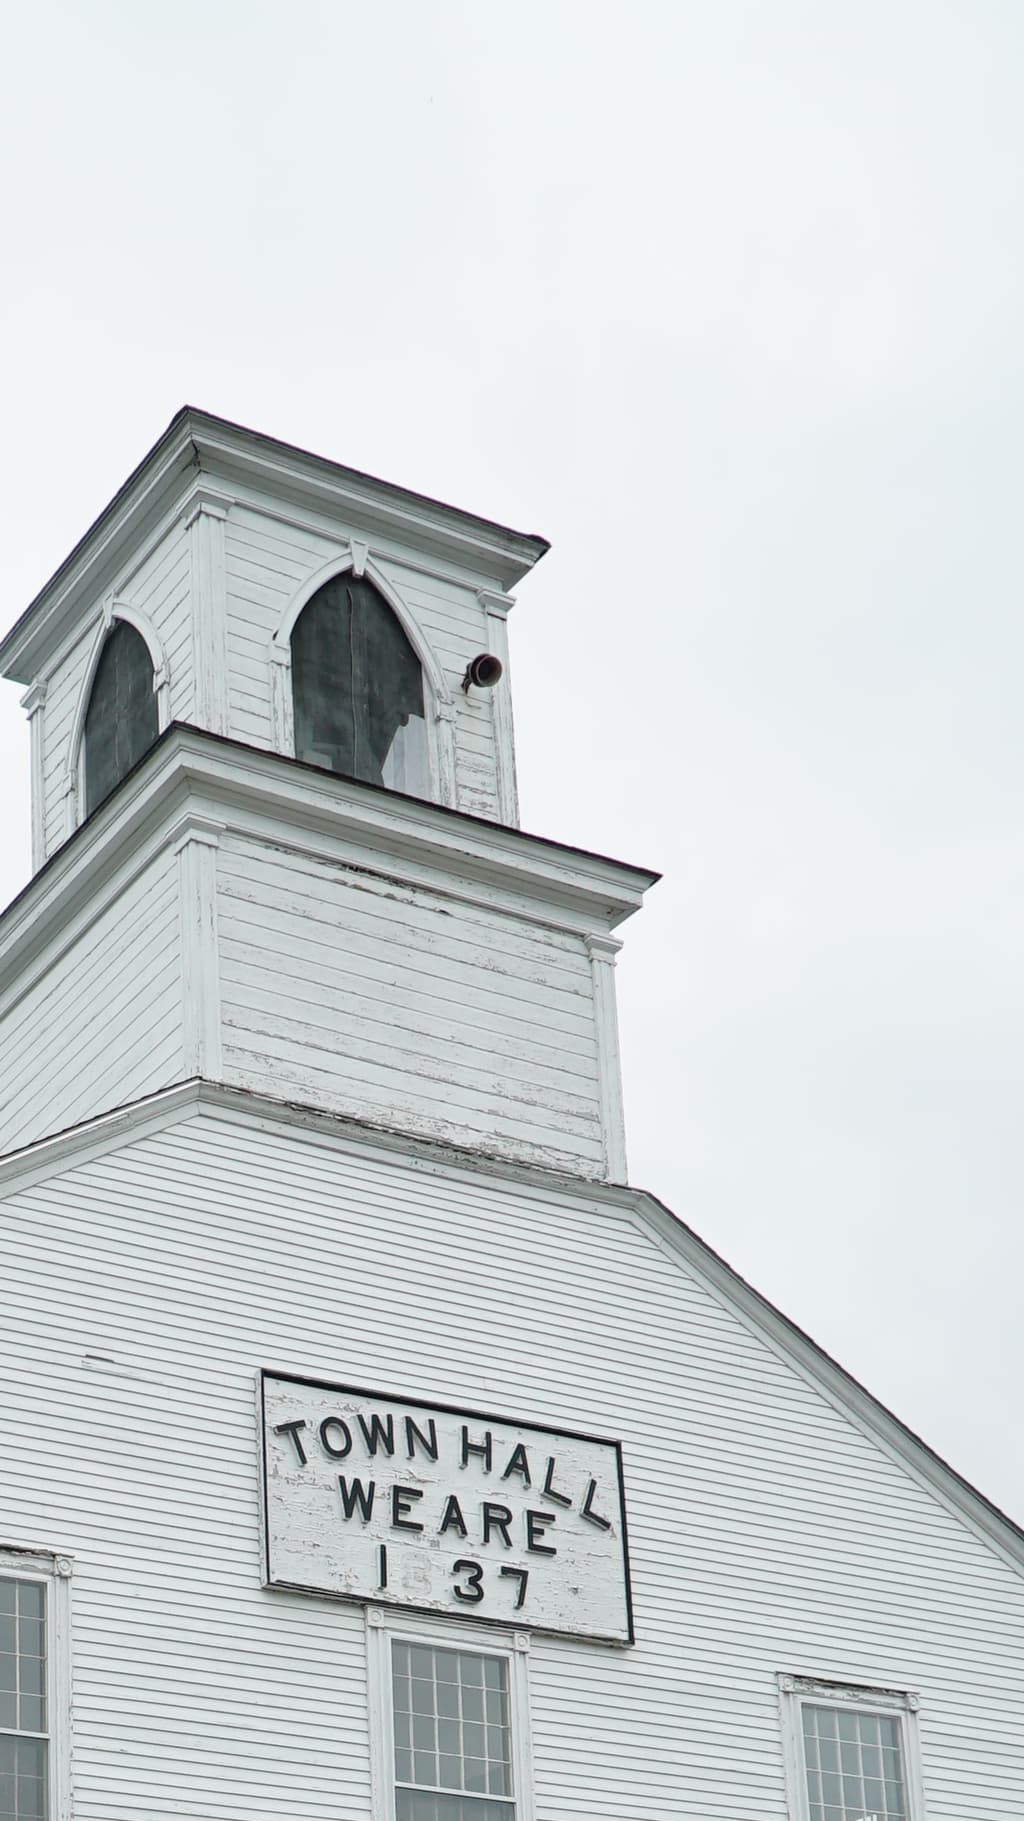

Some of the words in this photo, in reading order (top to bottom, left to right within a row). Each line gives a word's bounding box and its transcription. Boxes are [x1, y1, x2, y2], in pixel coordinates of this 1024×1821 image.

[274, 1413, 439, 1466] TOWN
[459, 1425, 612, 1531] HALL
[338, 1475, 557, 1555] WEARE
